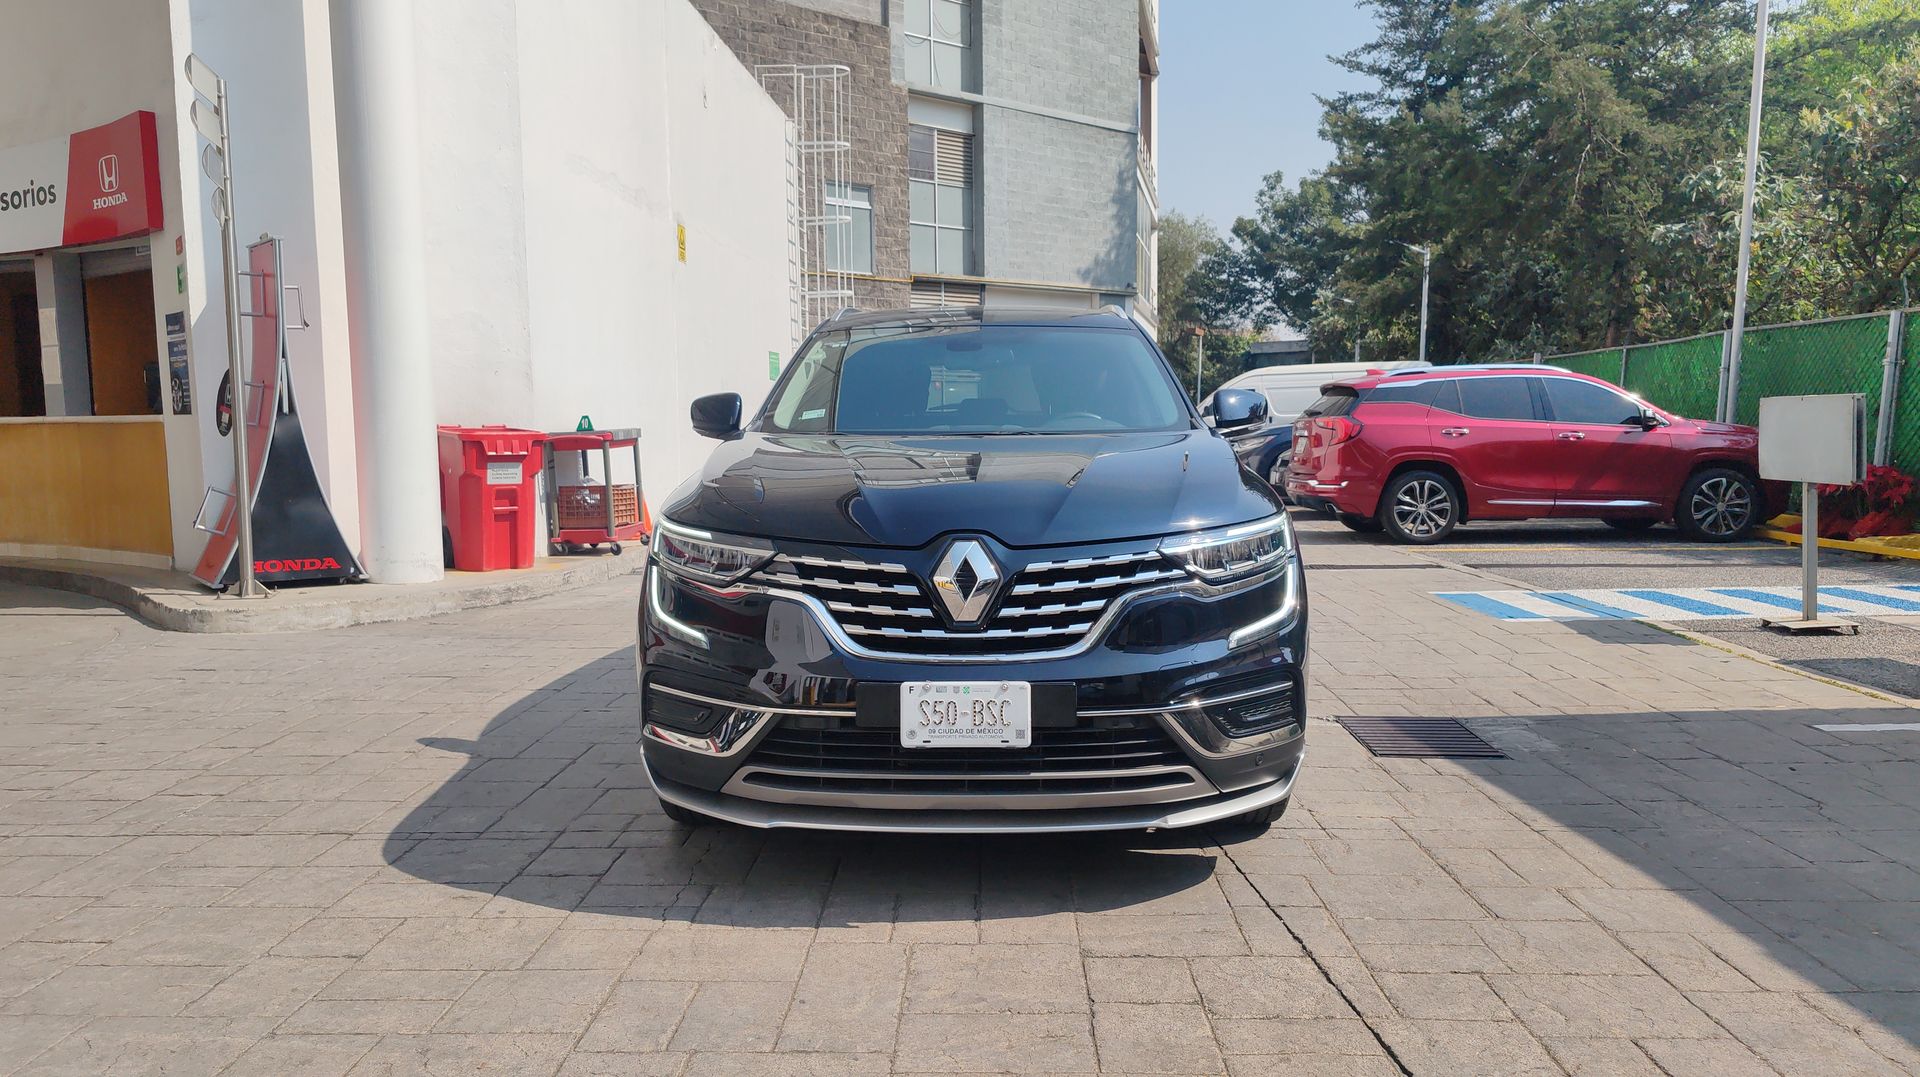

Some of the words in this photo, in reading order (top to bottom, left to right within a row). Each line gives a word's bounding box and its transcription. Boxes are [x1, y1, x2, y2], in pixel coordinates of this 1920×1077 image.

[0, 179, 57, 211] sorios
[92, 191, 128, 210] HONDA
[581, 418, 589, 429] 10
[909, 686, 914, 694] F
[919, 699, 1013, 727] S50-BSC
[977, 727, 1004, 735] MÉXICO
